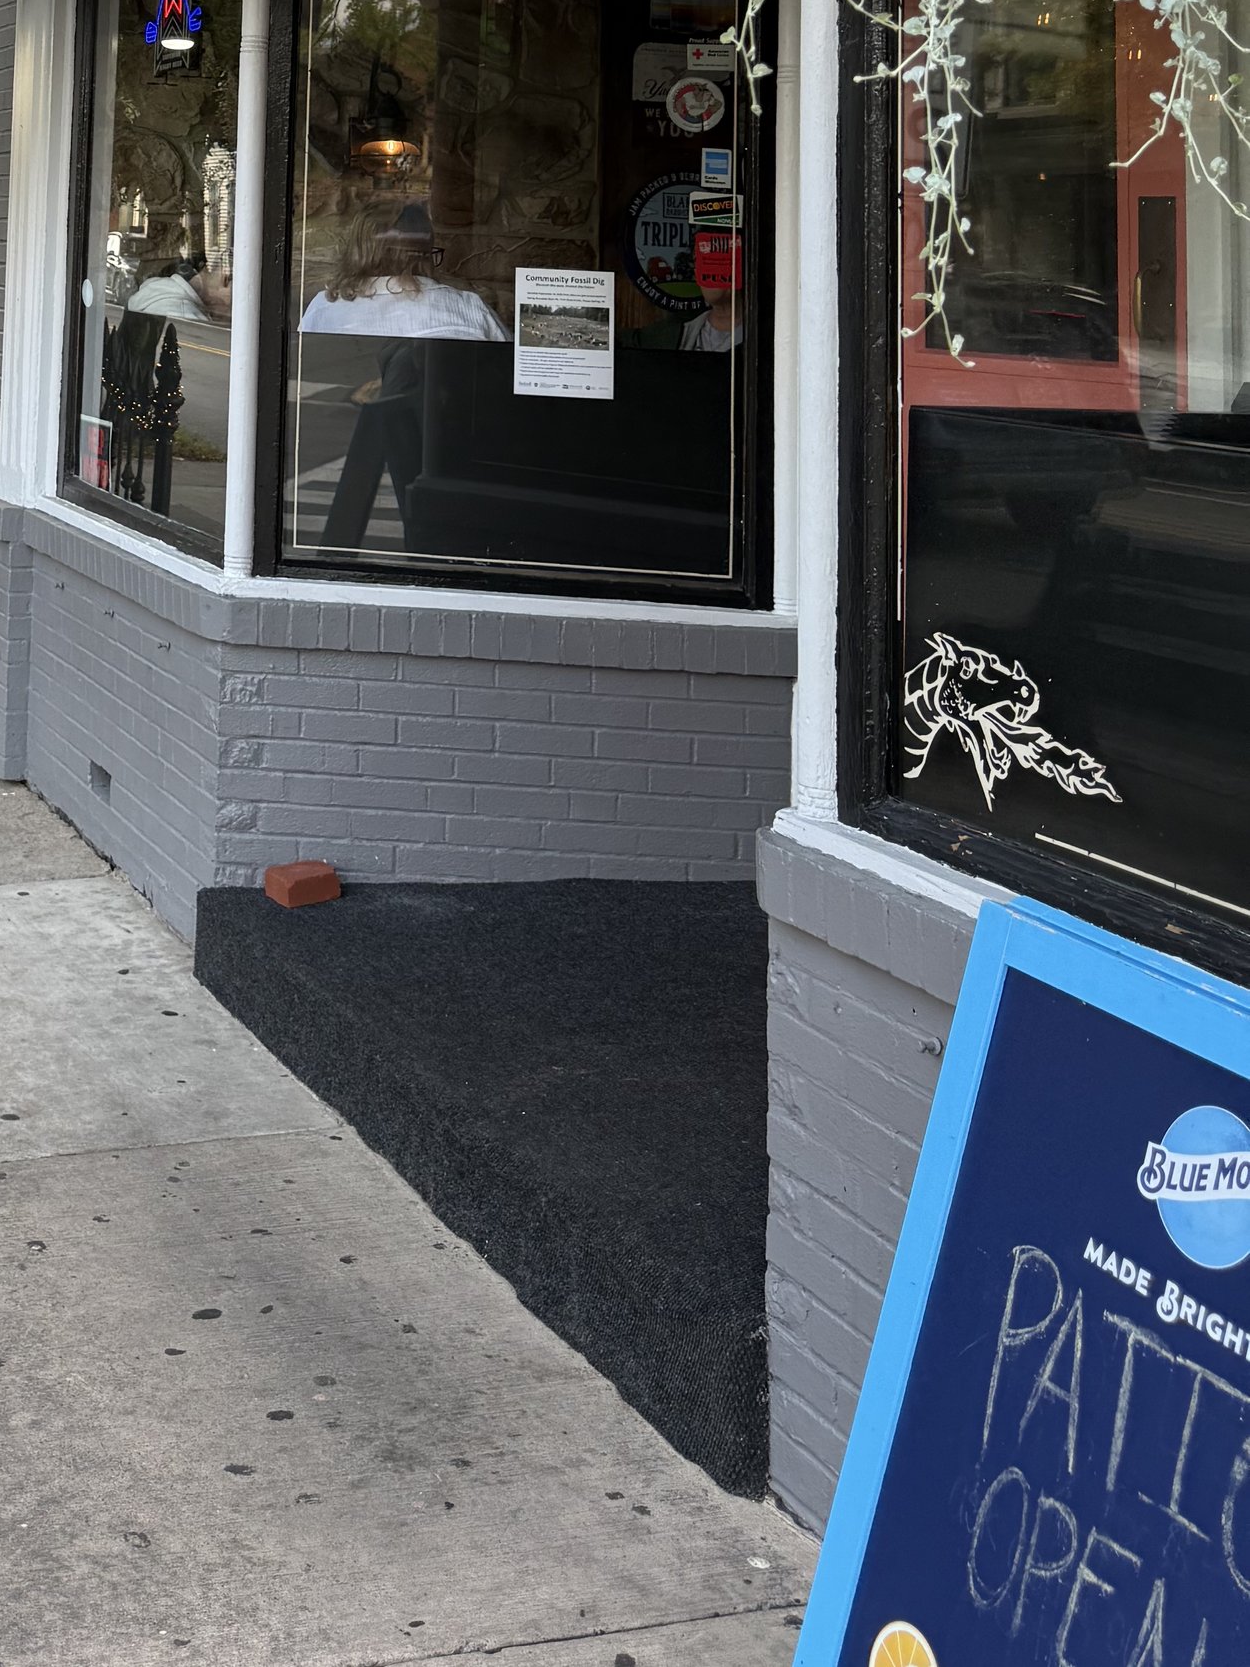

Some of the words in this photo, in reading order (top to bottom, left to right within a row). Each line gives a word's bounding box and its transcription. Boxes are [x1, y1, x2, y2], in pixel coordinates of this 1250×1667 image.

[693, 200, 736, 212] DISCOVE
[525, 274, 569, 284] Community
[570, 276, 591, 284] Fossil
[592, 277, 605, 286] Dig
[1140, 1146, 1211, 1194] BLUE
[1083, 1236, 1151, 1297] MADE
